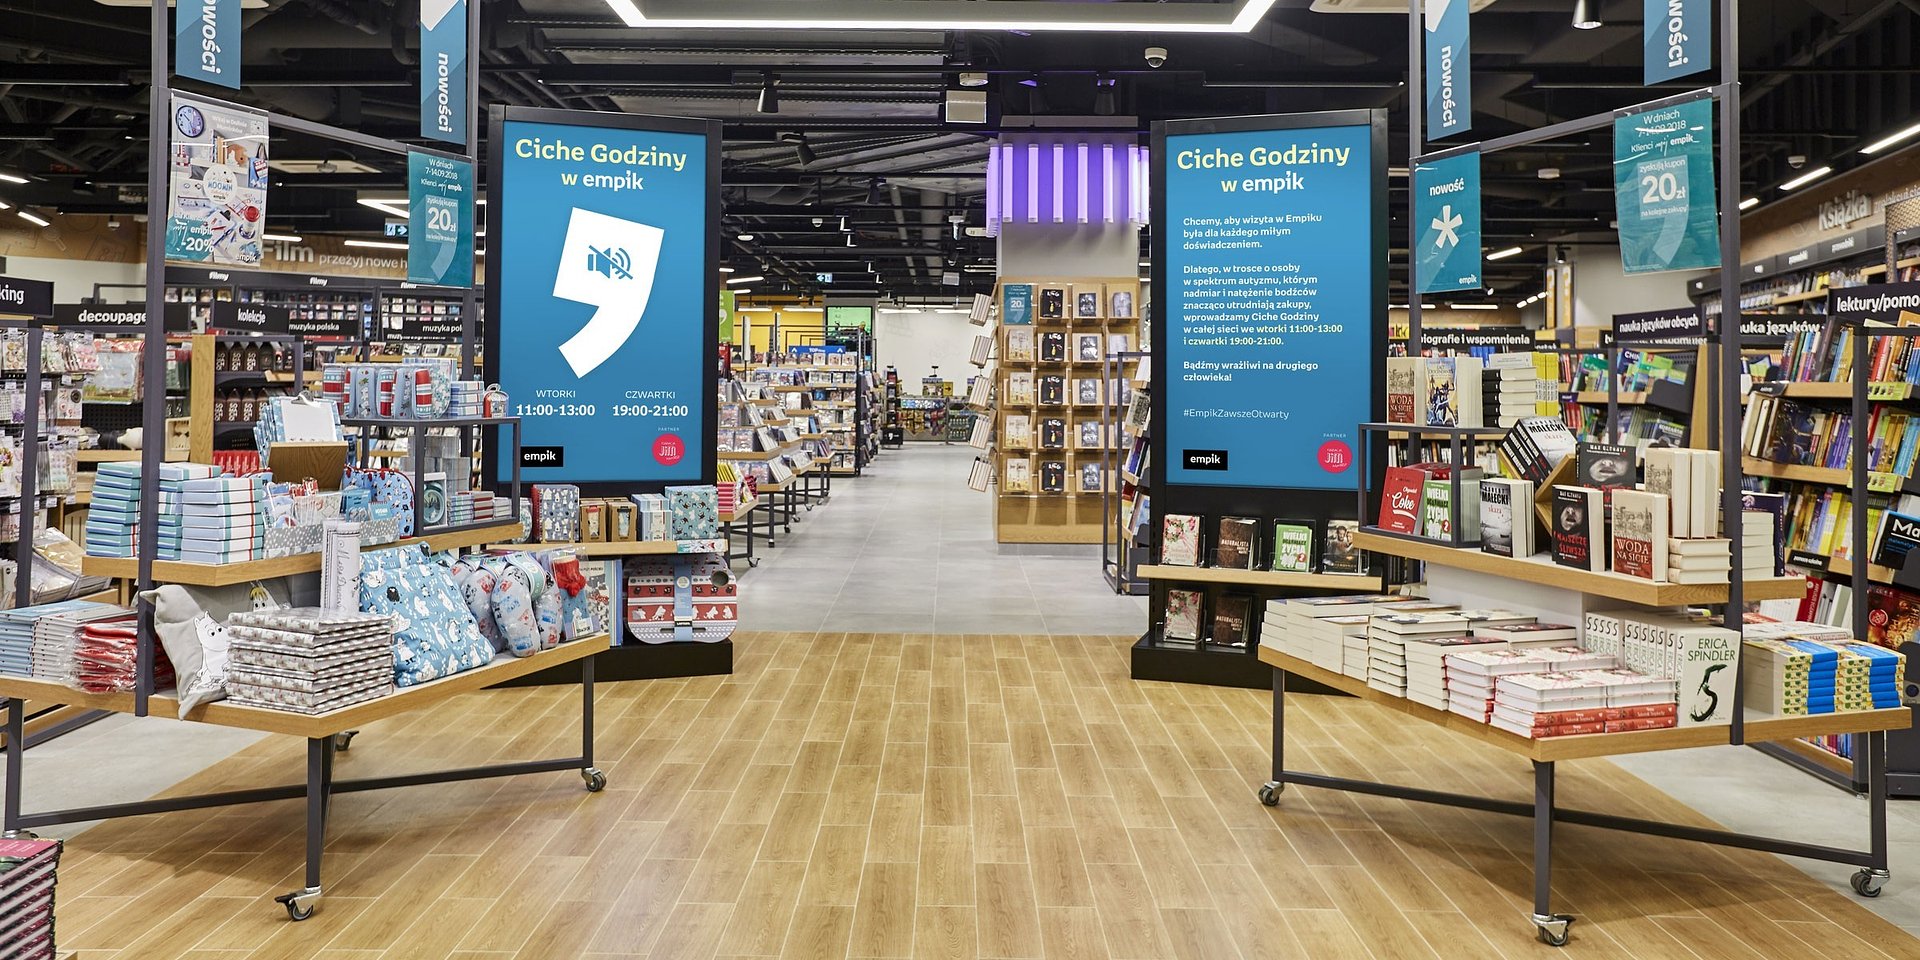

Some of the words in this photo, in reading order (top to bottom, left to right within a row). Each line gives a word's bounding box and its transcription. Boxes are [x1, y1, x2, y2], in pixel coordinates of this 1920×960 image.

[202, 0, 221, 74] wości
[438, 52, 453, 133] nowości
[1441, 46, 1457, 128] nowości
[1643, 115, 1654, 125] W
[1653, 109, 1681, 123] dniach
[1631, 140, 1655, 153] Klienci
[1670, 134, 1694, 147] empik
[515, 138, 585, 163] Ciche
[590, 143, 687, 172] Godziny
[1177, 147, 1244, 170] Ciche
[1249, 142, 1350, 167] Godziny
[1640, 161, 1664, 174] zyskują
[1663, 158, 1686, 170] kupon
[208, 181, 233, 192] MOOMIN
[561, 172, 578, 187] w
[582, 169, 644, 192] empik
[1221, 179, 1237, 192] w
[1242, 170, 1304, 194] empik
[448, 184, 463, 193] empik
[1429, 179, 1465, 197] nowość
[1818, 190, 1873, 231] Książka
[1183, 217, 1222, 227] Chcemy,
[1224, 216, 1241, 225] aby
[1242, 214, 1274, 225] wizyta
[1286, 213, 1322, 224] Empiku
[1183, 229, 1203, 239] była
[1204, 228, 1219, 237] dla
[1220, 227, 1259, 238] każdego
[1260, 226, 1291, 237] miłym
[182, 237, 214, 253] -20%
[1183, 240, 1263, 250] doświadczeniem.
[319, 253, 364, 268] przeżyj
[366, 257, 399, 268] nowe
[1183, 265, 1222, 276] Dlatego,
[1233, 265, 1262, 273] trosce
[1271, 263, 1300, 273] osoby
[1193, 277, 1237, 287] spektrum
[1238, 276, 1282, 287] autyzmu,
[1283, 275, 1318, 286] którym
[1458, 273, 1477, 286] empik
[1183, 288, 1221, 298] nadmiar
[1222, 289, 1226, 297] i
[1227, 288, 1273, 299] natężenie
[1274, 286, 1317, 297] bodźców
[1183, 302, 1225, 311] znacząco
[1226, 300, 1275, 310] utrudniają
[1276, 300, 1312, 310] zakupy,
[237, 307, 266, 326] kolekcje
[1183, 313, 1250, 323] wprowadzamy
[1251, 312, 1279, 321] Ciche
[1280, 312, 1319, 323] Godziny
[1619, 319, 1641, 333] nauka
[1641, 316, 1672, 333] języków
[1671, 313, 1699, 330] obcych
[289, 321, 316, 333] muzyka
[316, 321, 340, 333] polska
[422, 324, 450, 334] muzyka
[1193, 325, 1216, 335] całej
[1217, 325, 1239, 334] sieci
[1256, 324, 1287, 333] wtorki
[1289, 324, 1343, 334] 11:00-13:00
[1183, 337, 1187, 345] i
[1188, 336, 1228, 346] czwartki
[1229, 337, 1284, 346] 19:00-21:00.
[1461, 334, 1466, 344] i
[1466, 334, 1530, 347] wspomnienia
[1183, 361, 1220, 372] Bądźmy
[1221, 360, 1261, 371] wrażliwi
[1262, 363, 1275, 371] na
[1275, 361, 1319, 371] drugiego
[1183, 373, 1232, 382] człowieka!
[536, 389, 576, 399] WTORKI
[625, 390, 676, 400] CZWARTKI
[1389, 394, 1413, 406] WODA
[516, 404, 596, 417] 11:00-13:00
[612, 405, 689, 418] 19:00-21:00
[1183, 409, 1290, 421] #EmpikZawszeOtwarty
[524, 450, 556, 463] empik
[1190, 454, 1221, 465] empik
[1426, 488, 1449, 500] WIELKI
[1481, 491, 1509, 506] MAŁECKI
[1391, 492, 1415, 510] Coke
[1426, 504, 1448, 520] ŻYCIA
[1443, 521, 1448, 532] 2
[1616, 538, 1649, 555] WODA
[1616, 551, 1628, 560] NA
[1628, 553, 1650, 564] SICIE
[1697, 638, 1729, 650] ERICA
[1687, 649, 1736, 662] SPINDLER
